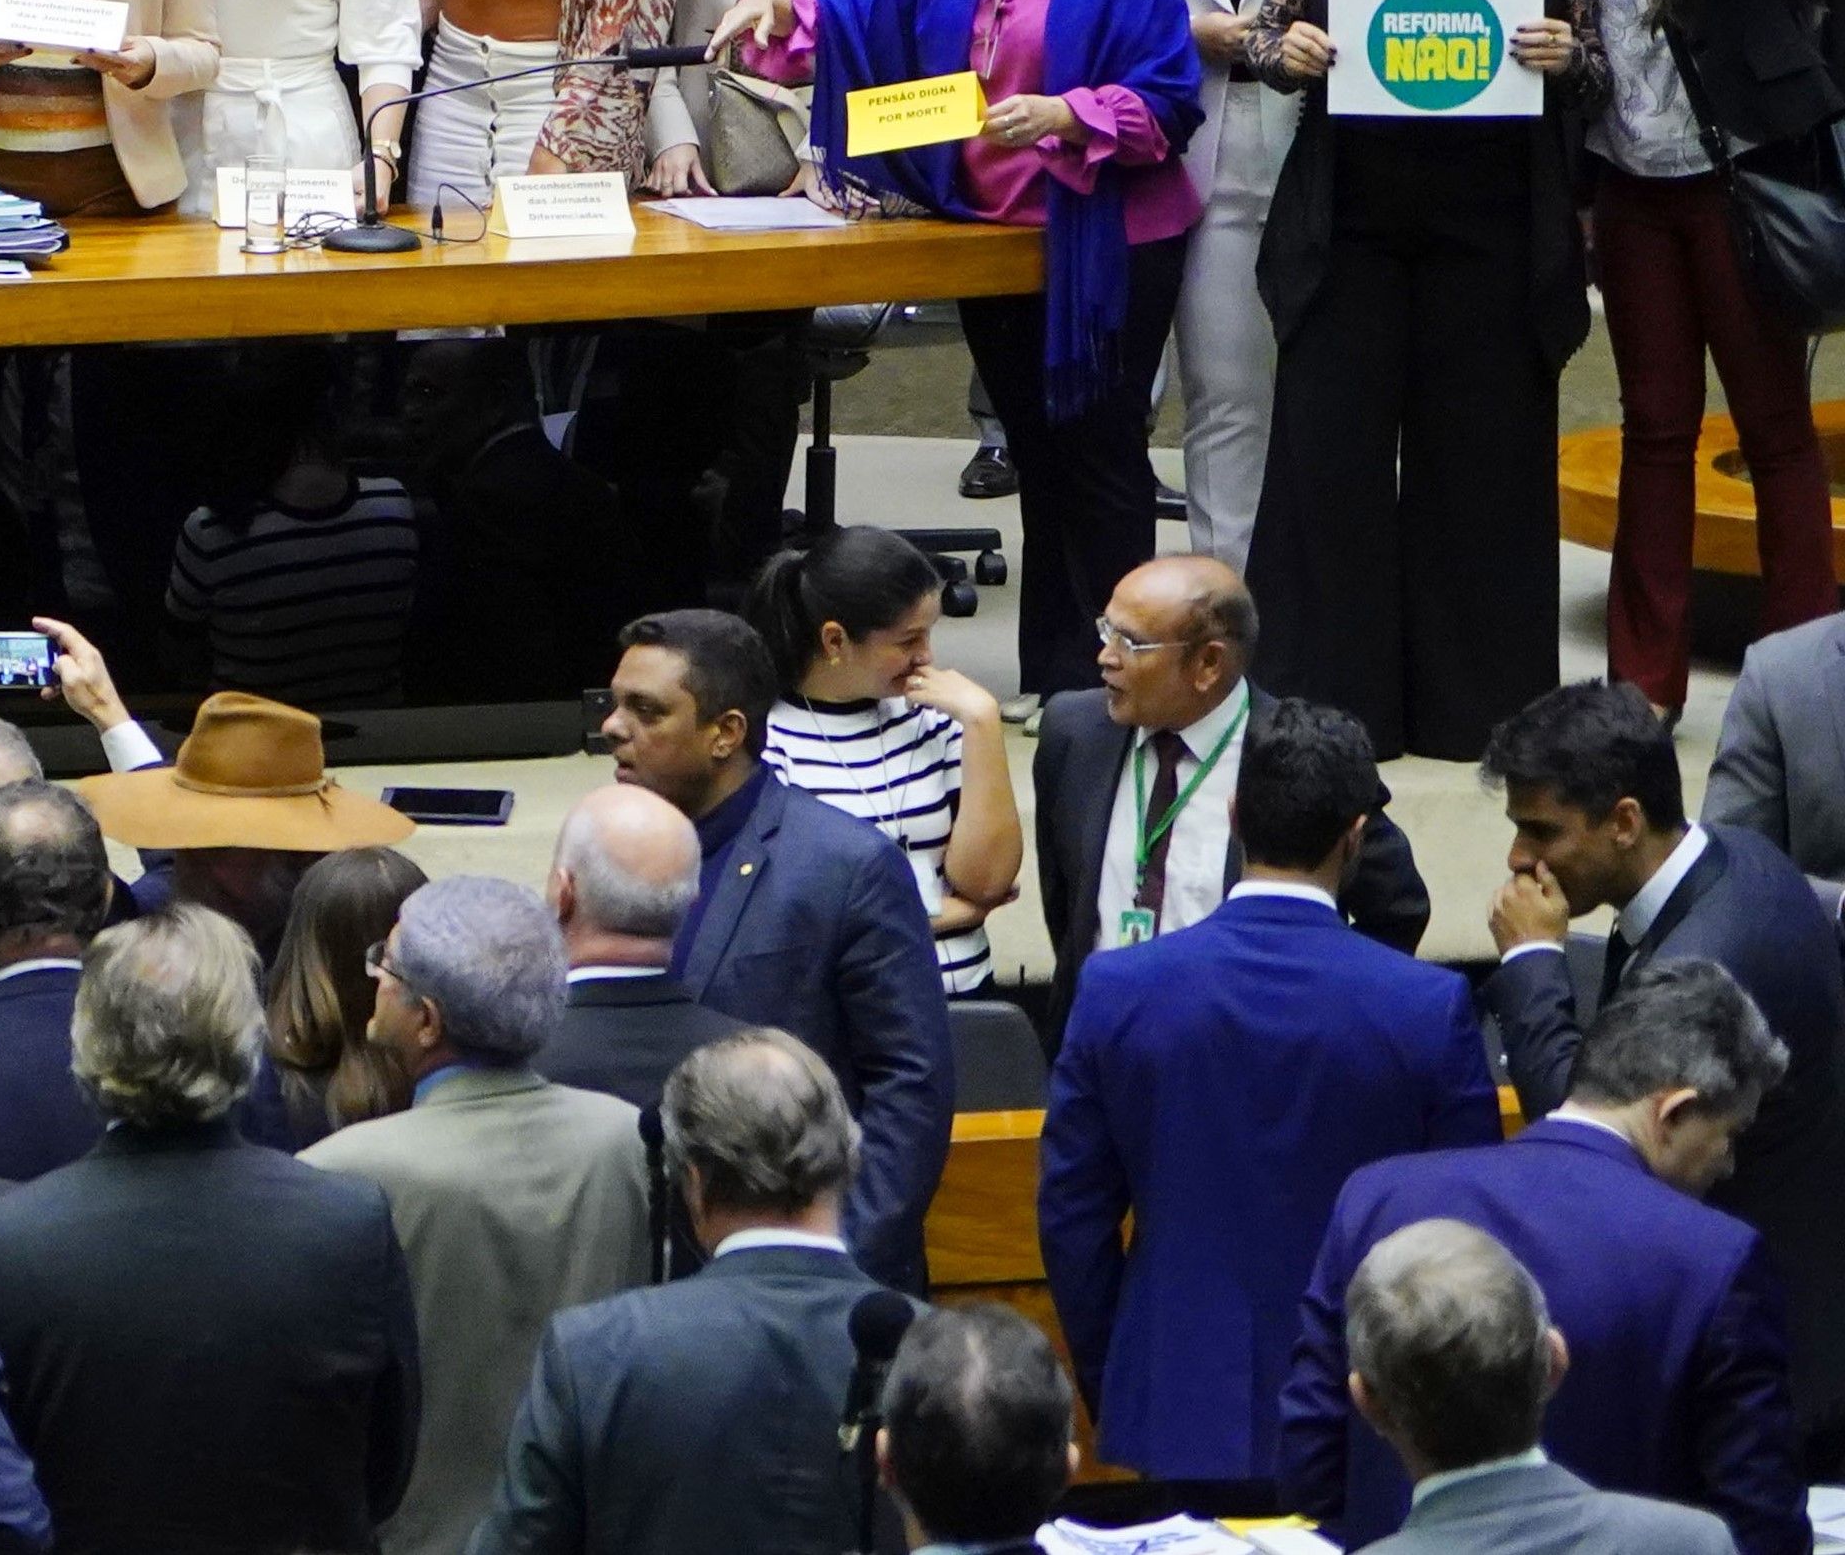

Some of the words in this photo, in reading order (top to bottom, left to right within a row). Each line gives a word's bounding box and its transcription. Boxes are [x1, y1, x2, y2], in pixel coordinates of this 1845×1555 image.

[1383, 12, 1491, 37] REFORMA,
[1385, 33, 1491, 82] NÃO!
[868, 91, 916, 106] PENSÃO
[919, 84, 957, 97] DIGNA
[878, 113, 902, 123] POR
[906, 105, 947, 119] MORTE
[512, 180, 612, 191] Desconhecimento
[528, 196, 547, 204] das
[551, 195, 601, 204] Jornadas
